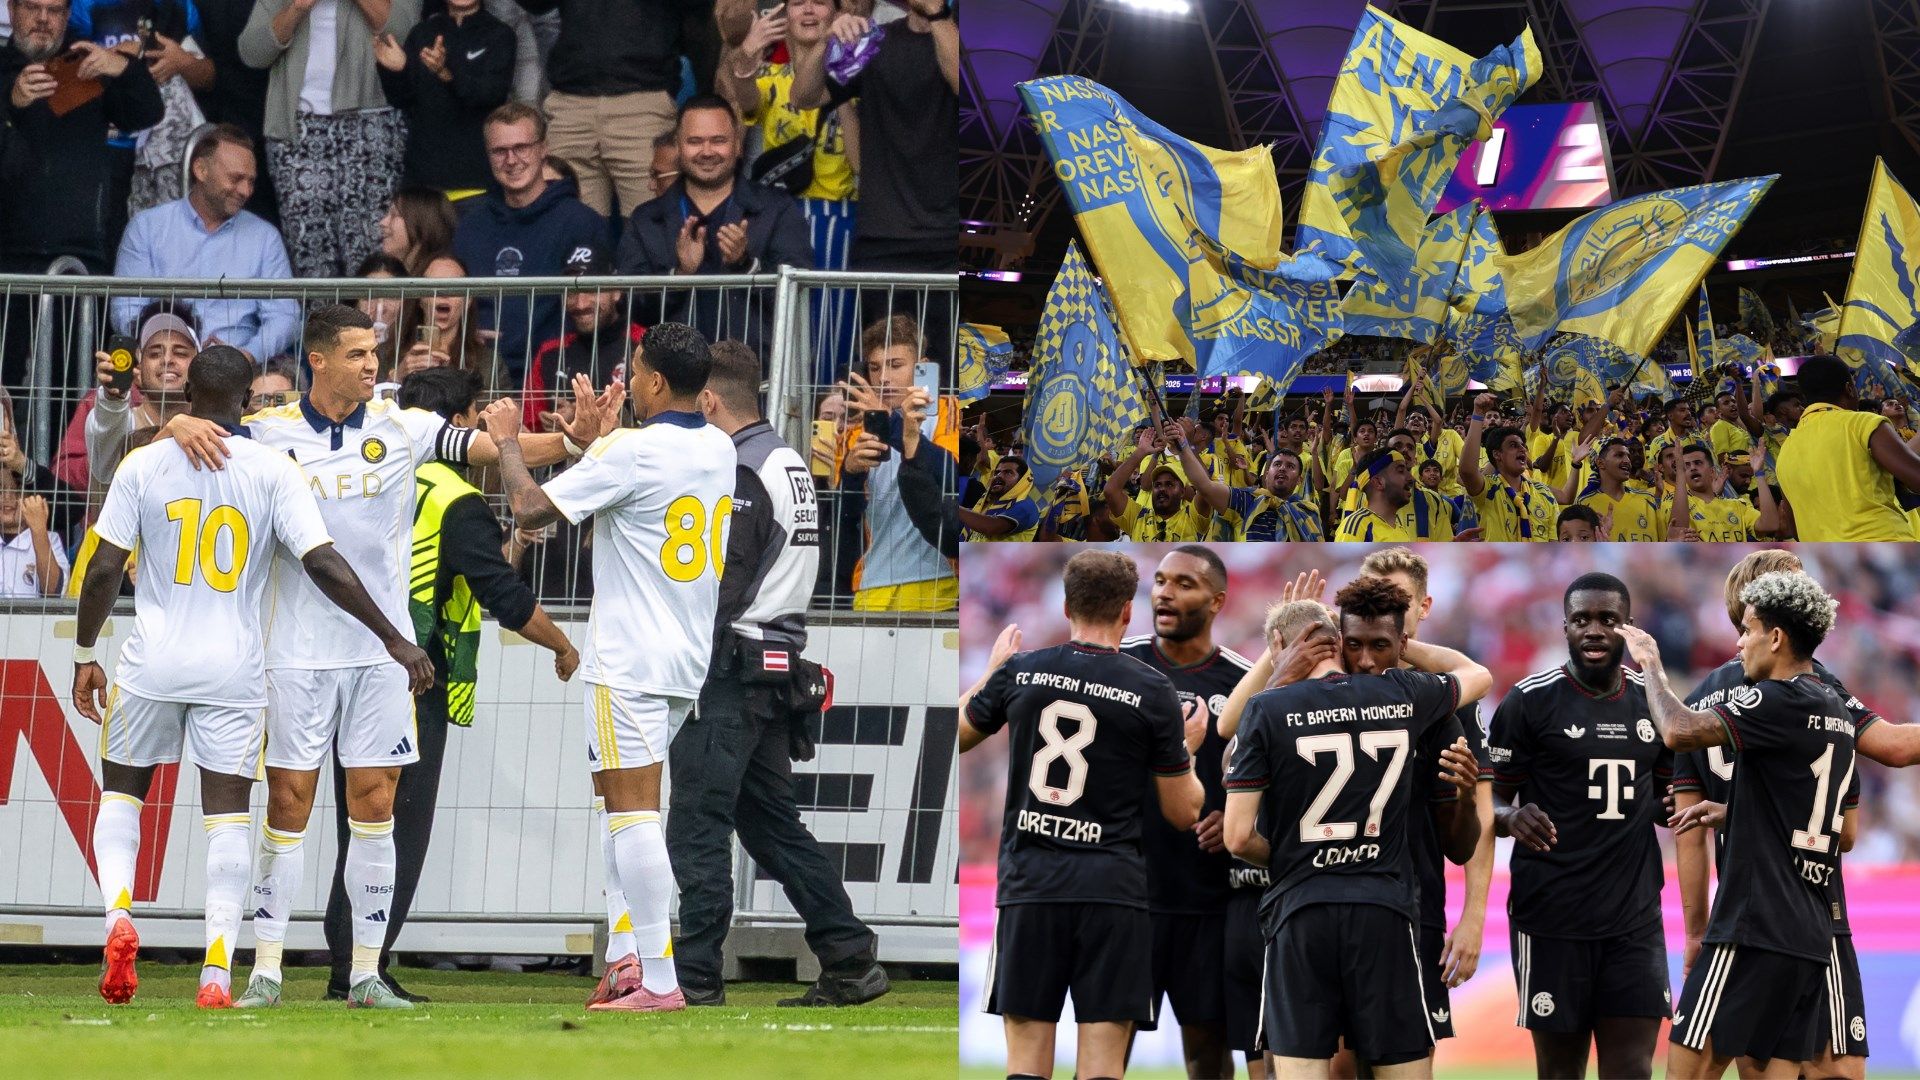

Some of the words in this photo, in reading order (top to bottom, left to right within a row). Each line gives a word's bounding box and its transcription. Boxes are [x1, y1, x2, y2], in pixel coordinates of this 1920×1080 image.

[1067, 119, 1123, 152] NAS
[1055, 144, 1137, 182] OREV
[1219, 317, 1302, 350] NASSR
[165, 497, 249, 593] 10
[1016, 672, 1031, 685] FC
[1031, 672, 1081, 692] BAYERN
[1286, 713, 1304, 727] FC
[1306, 707, 1357, 726] BAYERN
[1807, 715, 1822, 730] FC
[1028, 699, 1098, 807] 8
[1296, 729, 1410, 843] 27
[1588, 758, 1636, 820] T
